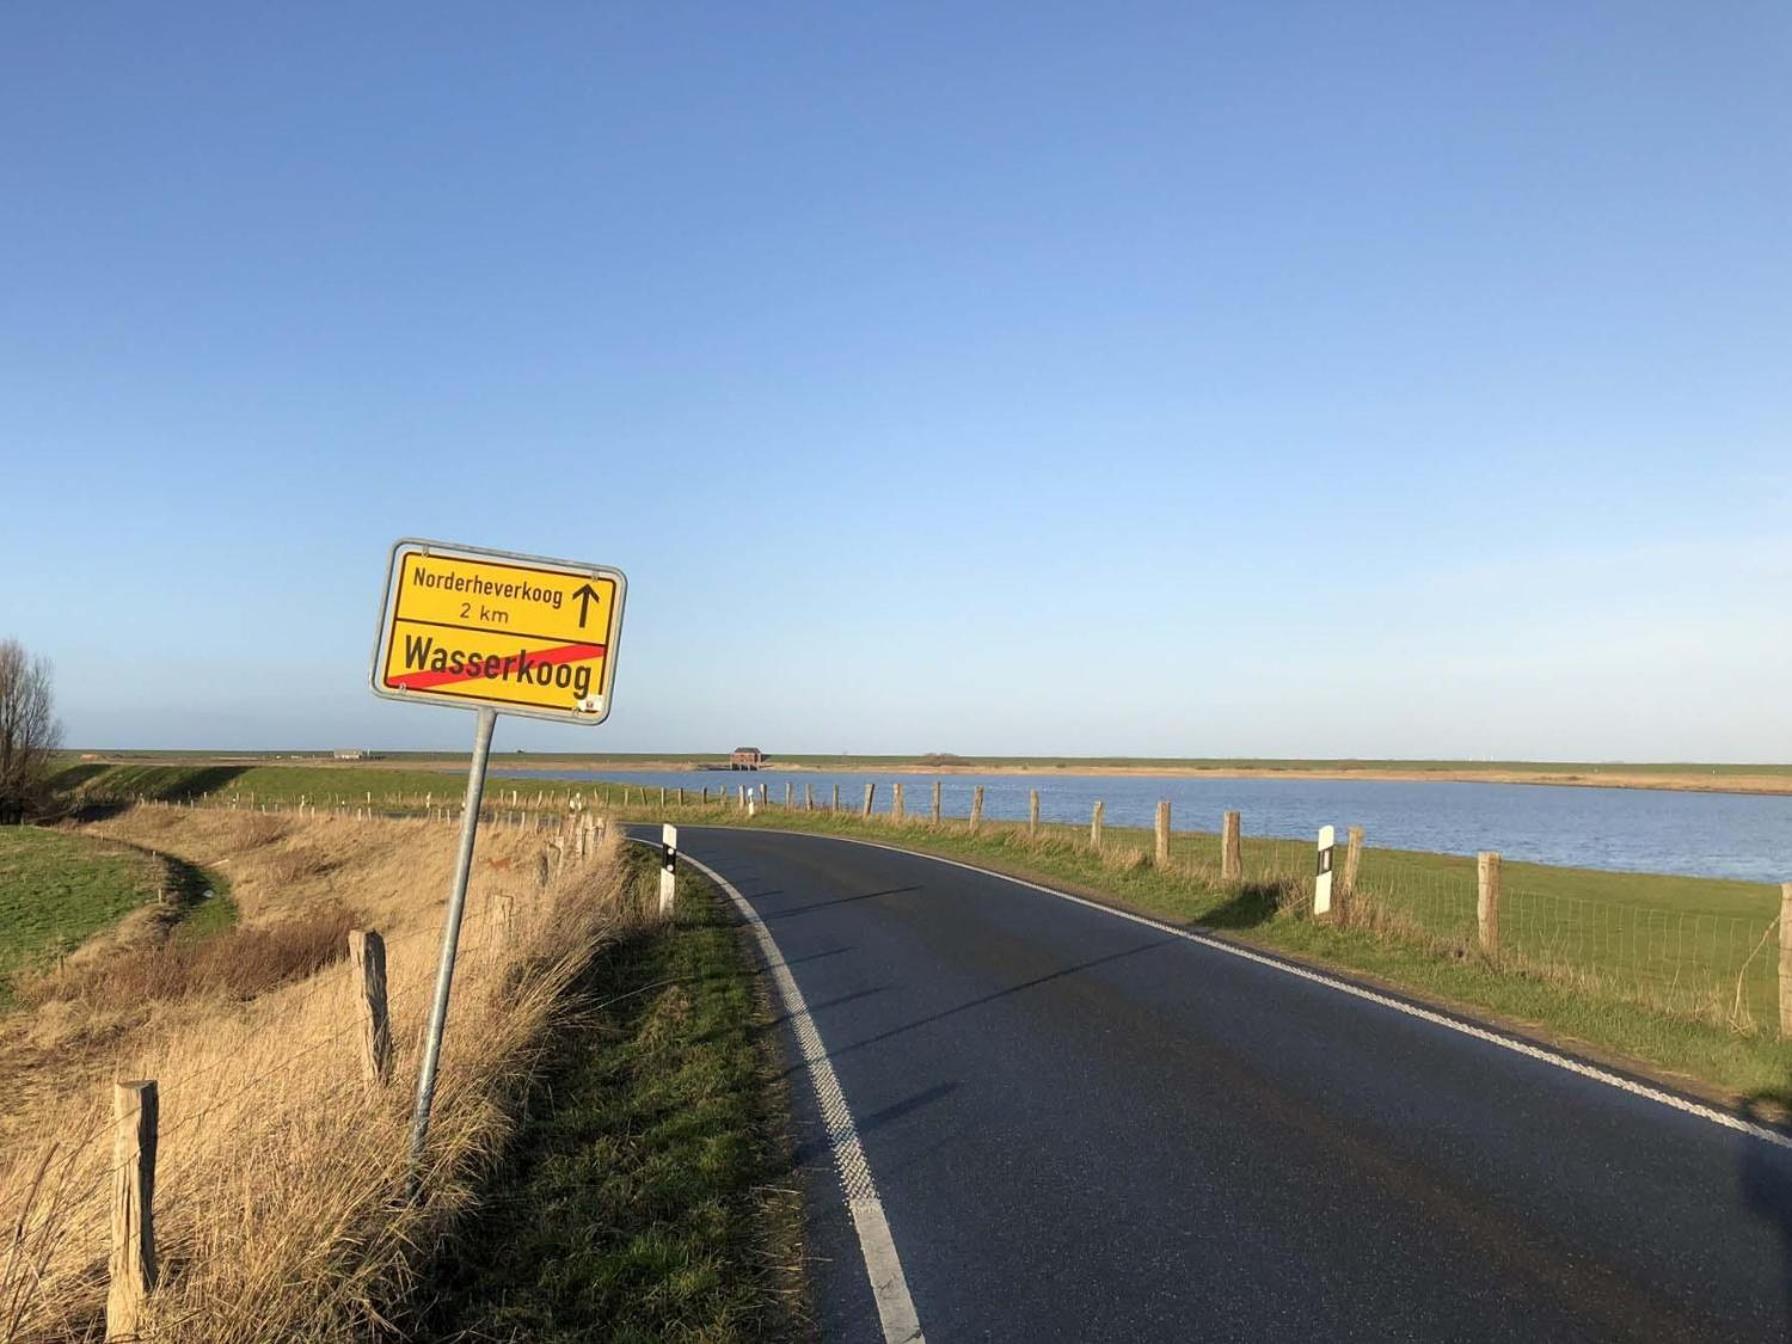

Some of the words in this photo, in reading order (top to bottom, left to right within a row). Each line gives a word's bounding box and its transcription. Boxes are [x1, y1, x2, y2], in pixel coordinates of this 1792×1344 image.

[413, 567, 563, 609] Norderheverkoog
[459, 603, 472, 619] 2
[480, 605, 509, 624] km
[405, 634, 592, 700] Wasserkoog
